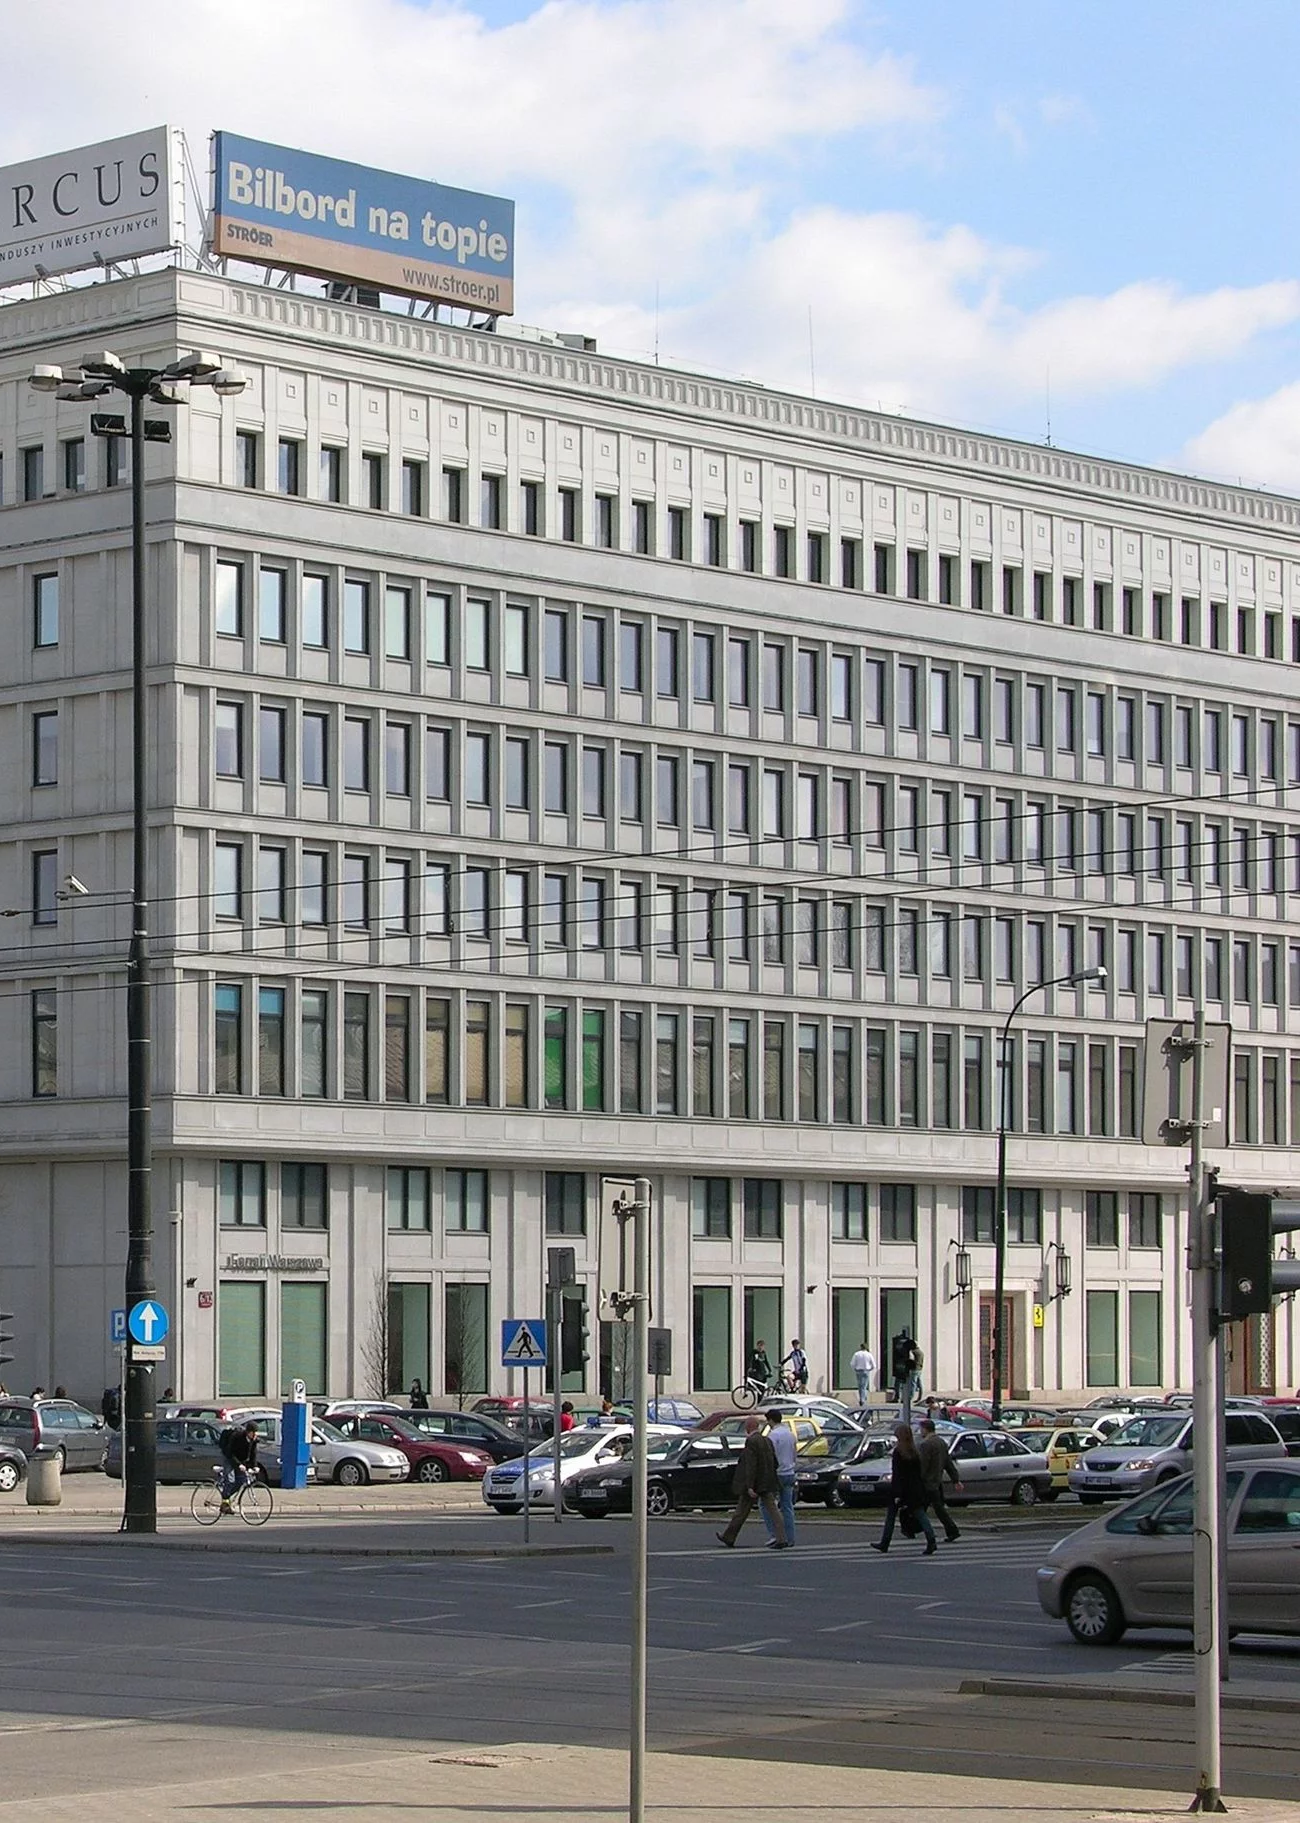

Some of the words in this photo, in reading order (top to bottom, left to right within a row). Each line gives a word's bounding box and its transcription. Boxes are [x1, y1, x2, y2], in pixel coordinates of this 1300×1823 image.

[227, 160, 357, 229] Bilbord
[368, 206, 409, 241] na
[421, 211, 508, 265] topie
[50, 216, 160, 250] INWESTYCYJNYCH
[402, 266, 500, 304] www.stroer.pl
[114, 1312, 125, 1338] P
